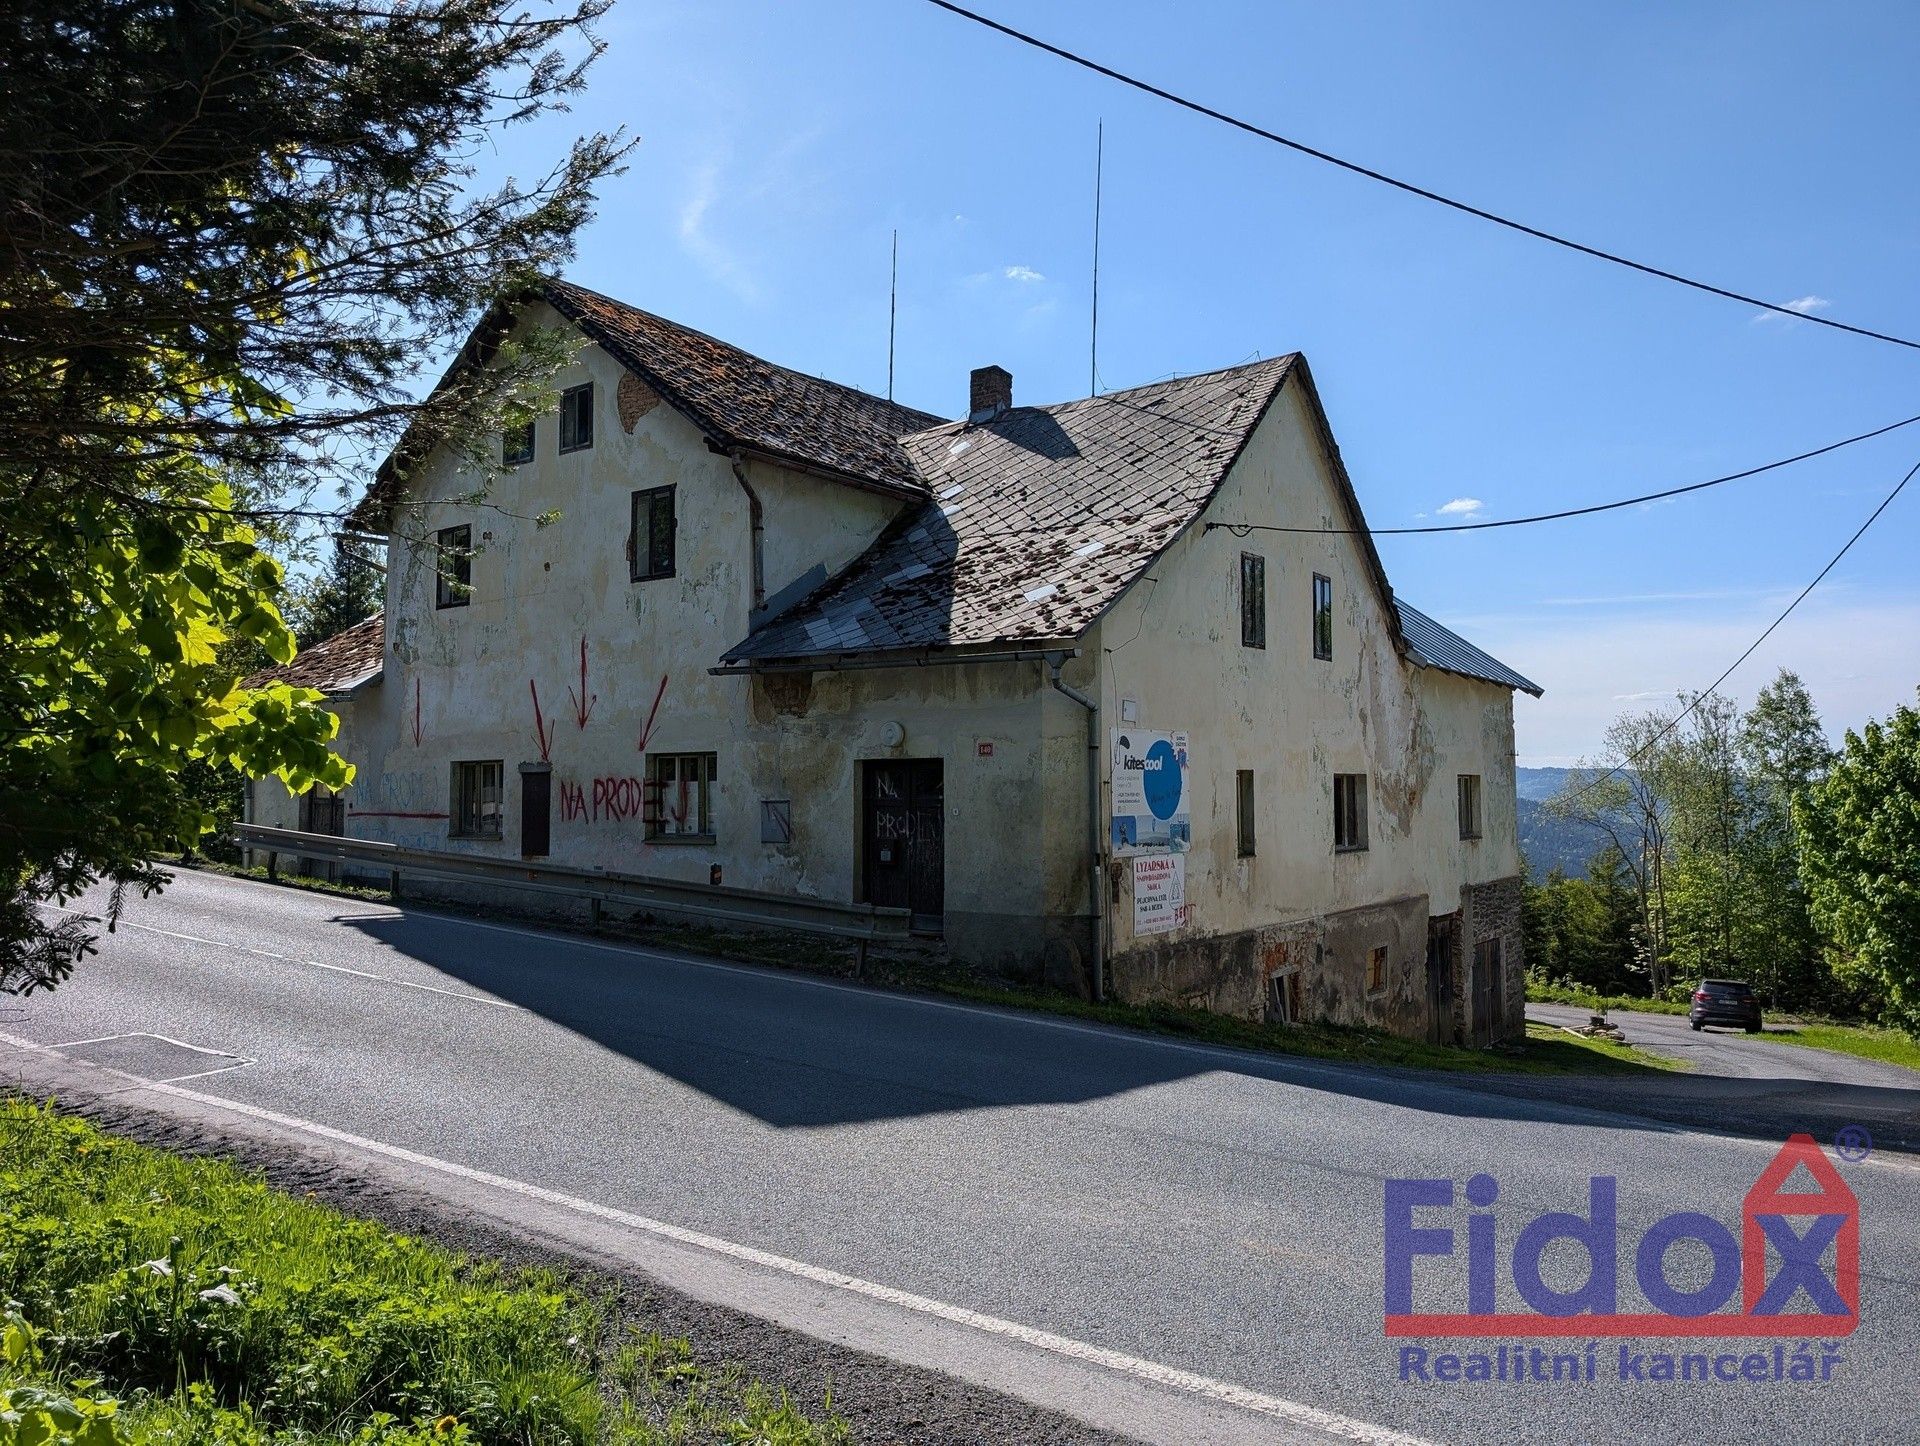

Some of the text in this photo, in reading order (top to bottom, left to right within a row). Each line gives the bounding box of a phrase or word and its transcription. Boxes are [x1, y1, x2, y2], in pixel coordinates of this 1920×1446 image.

[1123, 754, 1163, 771] kitescool
[561, 776, 688, 825] NA PRODEJ
